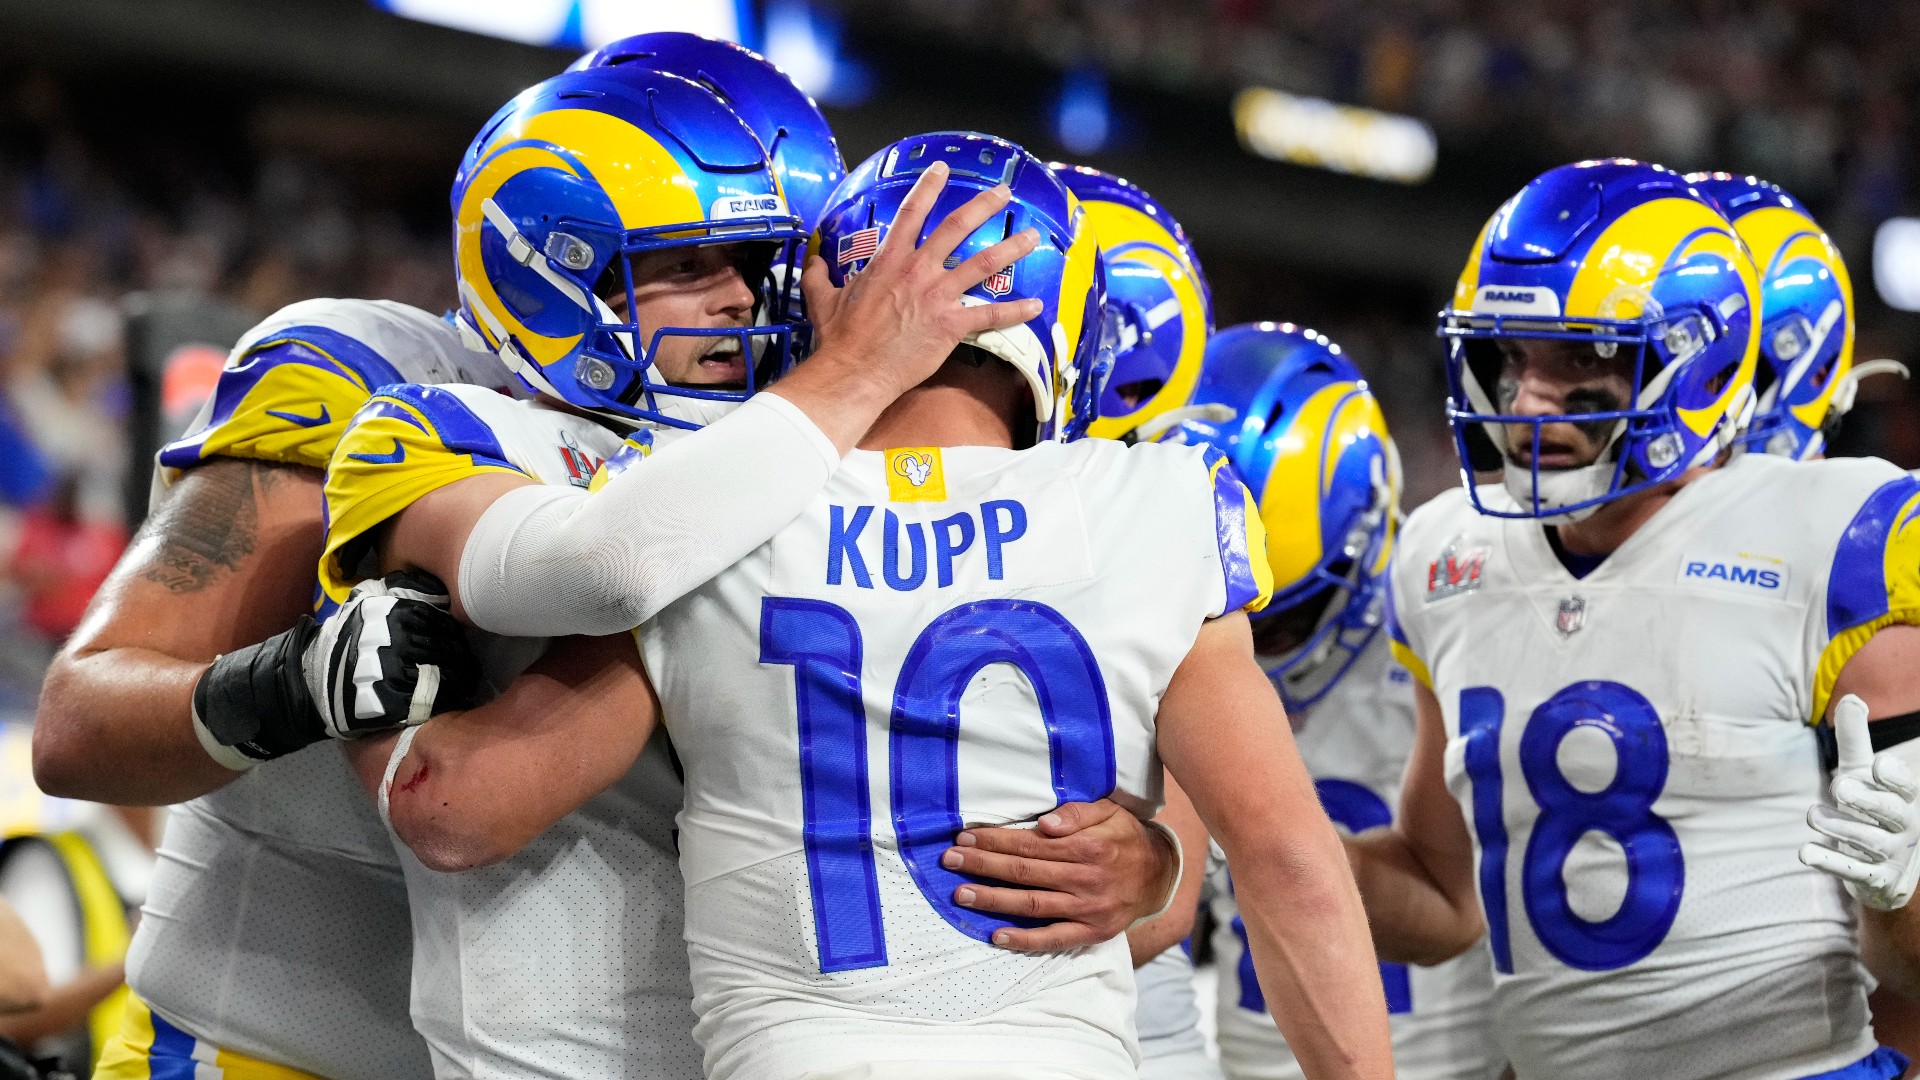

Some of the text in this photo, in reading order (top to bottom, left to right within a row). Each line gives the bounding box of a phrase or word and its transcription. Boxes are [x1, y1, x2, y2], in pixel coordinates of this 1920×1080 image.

[729, 199, 778, 213] RAMS
[987, 274, 1009, 291] NFL
[1484, 291, 1536, 304] RAMS
[827, 499, 1028, 592] KUPP
[1685, 562, 1780, 588] RAMS
[759, 596, 1117, 974] 10
[1459, 679, 1685, 975] 18
